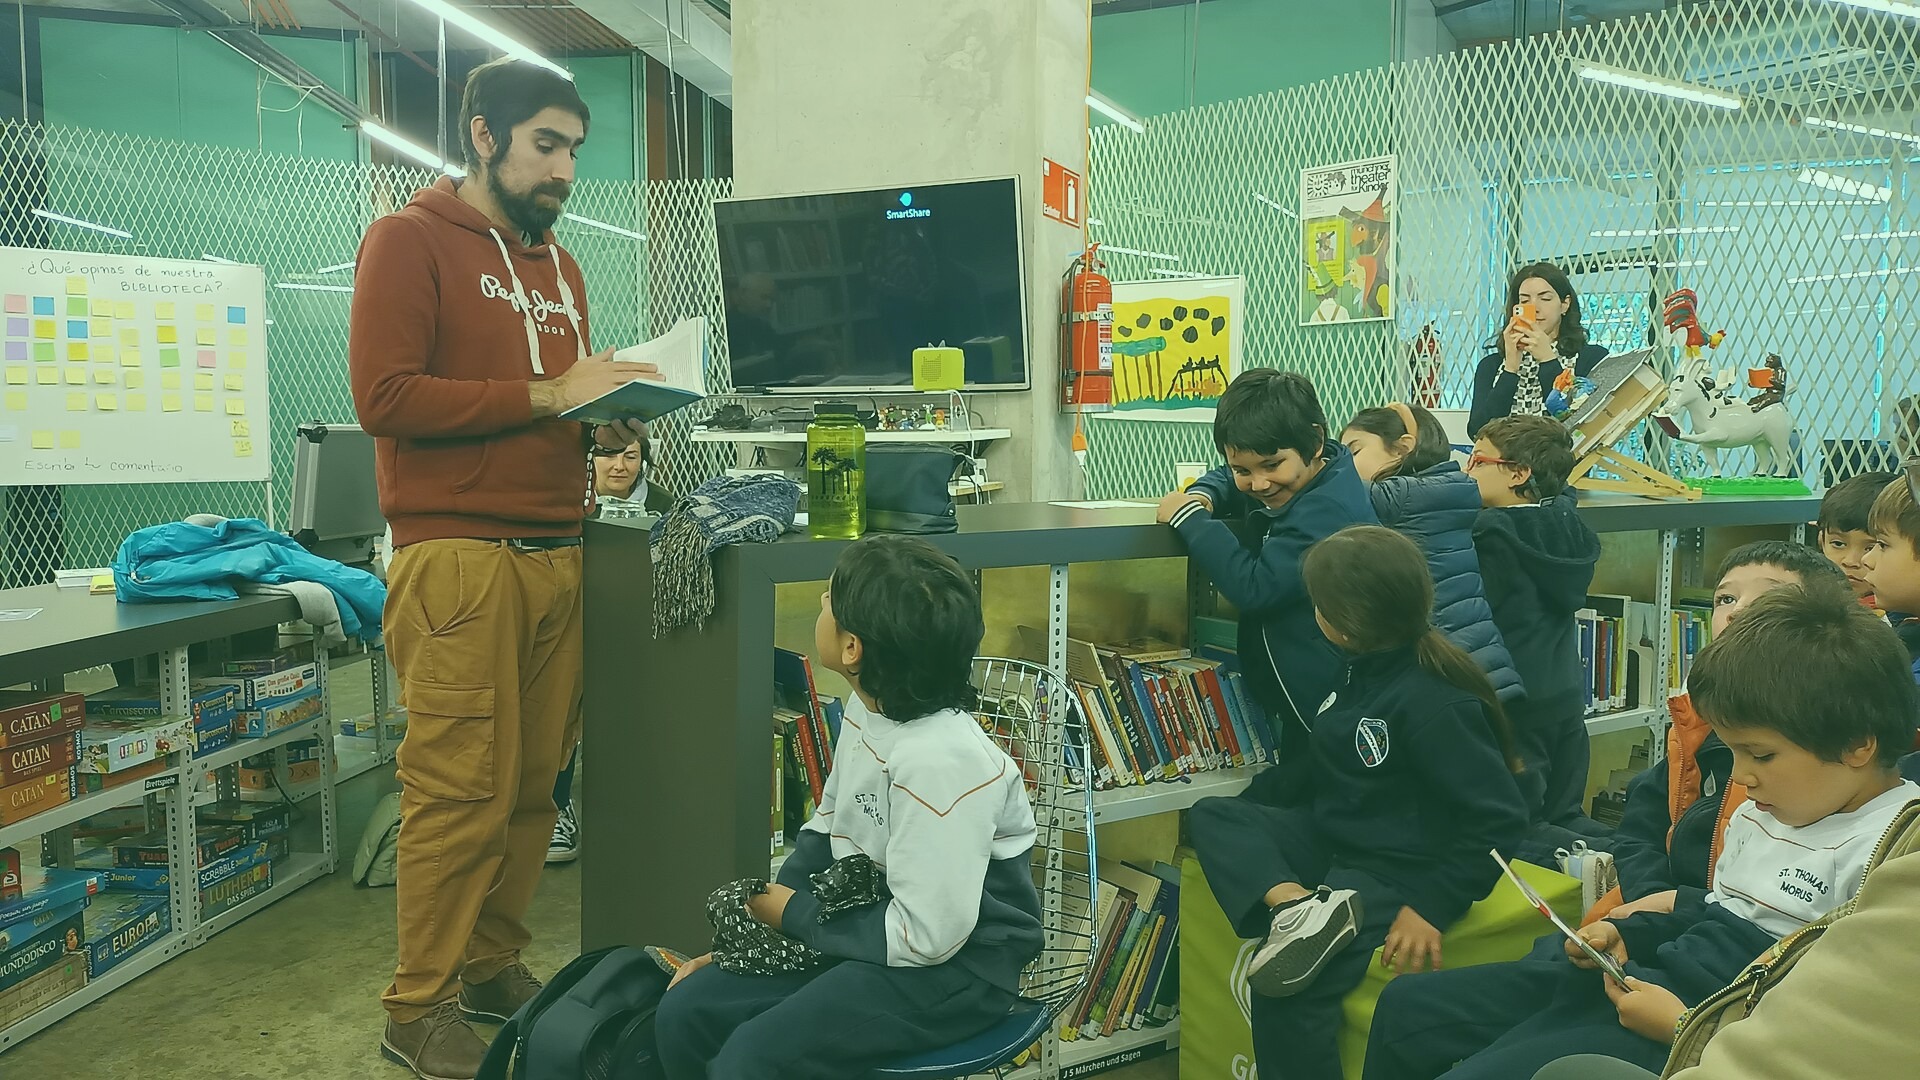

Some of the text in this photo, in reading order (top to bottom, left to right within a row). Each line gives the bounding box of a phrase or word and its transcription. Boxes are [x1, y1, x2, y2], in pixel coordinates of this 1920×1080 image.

[886, 208, 931, 220] SmartShare
[80, 266, 125, 284] opinas
[135, 264, 152, 277] de
[161, 268, 216, 279] nuestra
[10, 711, 51, 734] CATAN
[11, 743, 51, 770] CATAN
[145, 777, 176, 788] Brettspiele
[11, 782, 45, 808] CATAN
[110, 873, 136, 881] Junior
[200, 860, 236, 884] SCRABBLE
[1778, 868, 1829, 895] ST. THOMAS
[209, 869, 255, 905] LUTHER
[227, 886, 256, 906] DAS SPIEL
[1779, 881, 1813, 903] MORUS
[31, 899, 50, 910] juego
[1063, 1070, 1068, 1079] J
[1075, 1060, 1106, 1076] Märchen
[1106, 1057, 1120, 1067] und
[1120, 1050, 1141, 1063] Sagen
